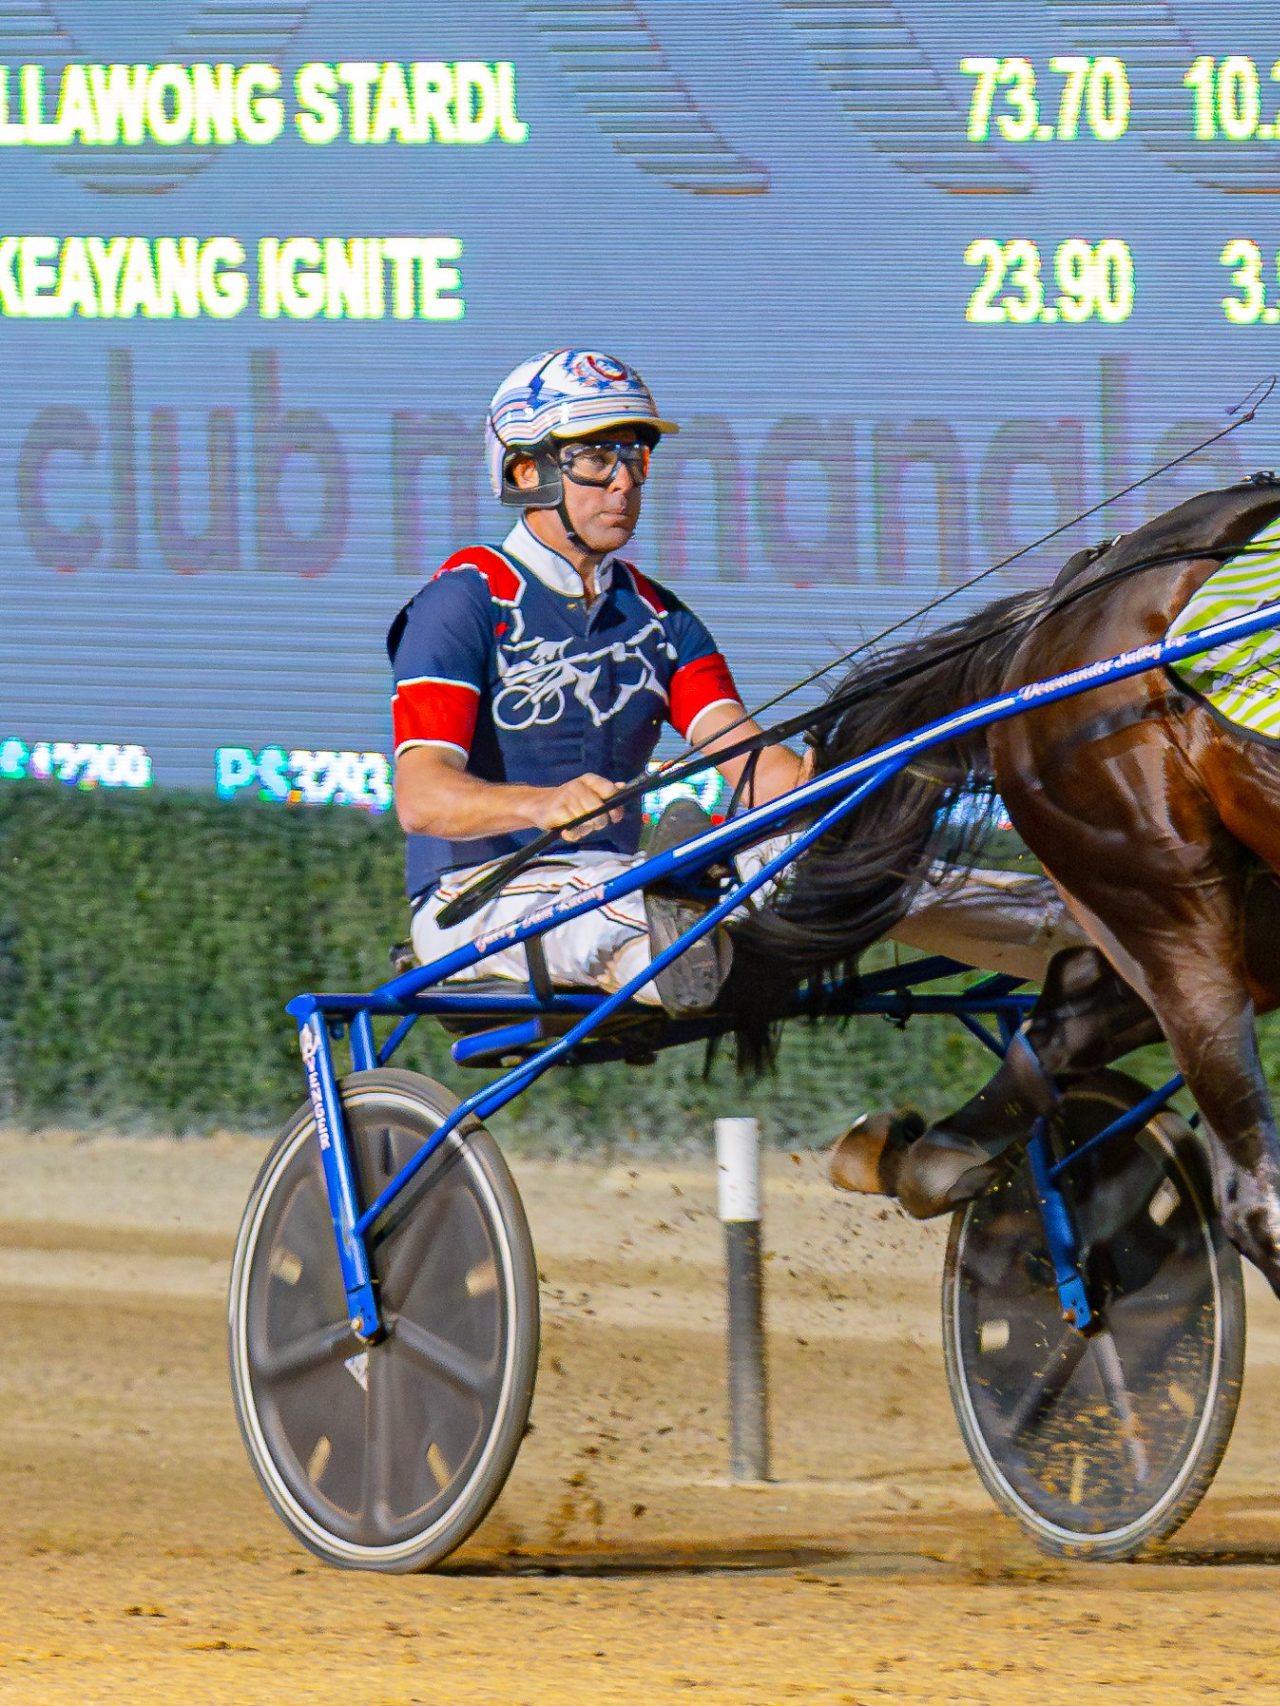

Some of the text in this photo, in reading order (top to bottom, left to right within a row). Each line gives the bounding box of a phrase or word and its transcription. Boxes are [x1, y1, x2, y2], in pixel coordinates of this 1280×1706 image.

[959, 56, 1130, 142] 73.70
[257, 236, 466, 320] IGNITE
[964, 238, 1136, 323] 23.90
[18, 350, 350, 578] club
